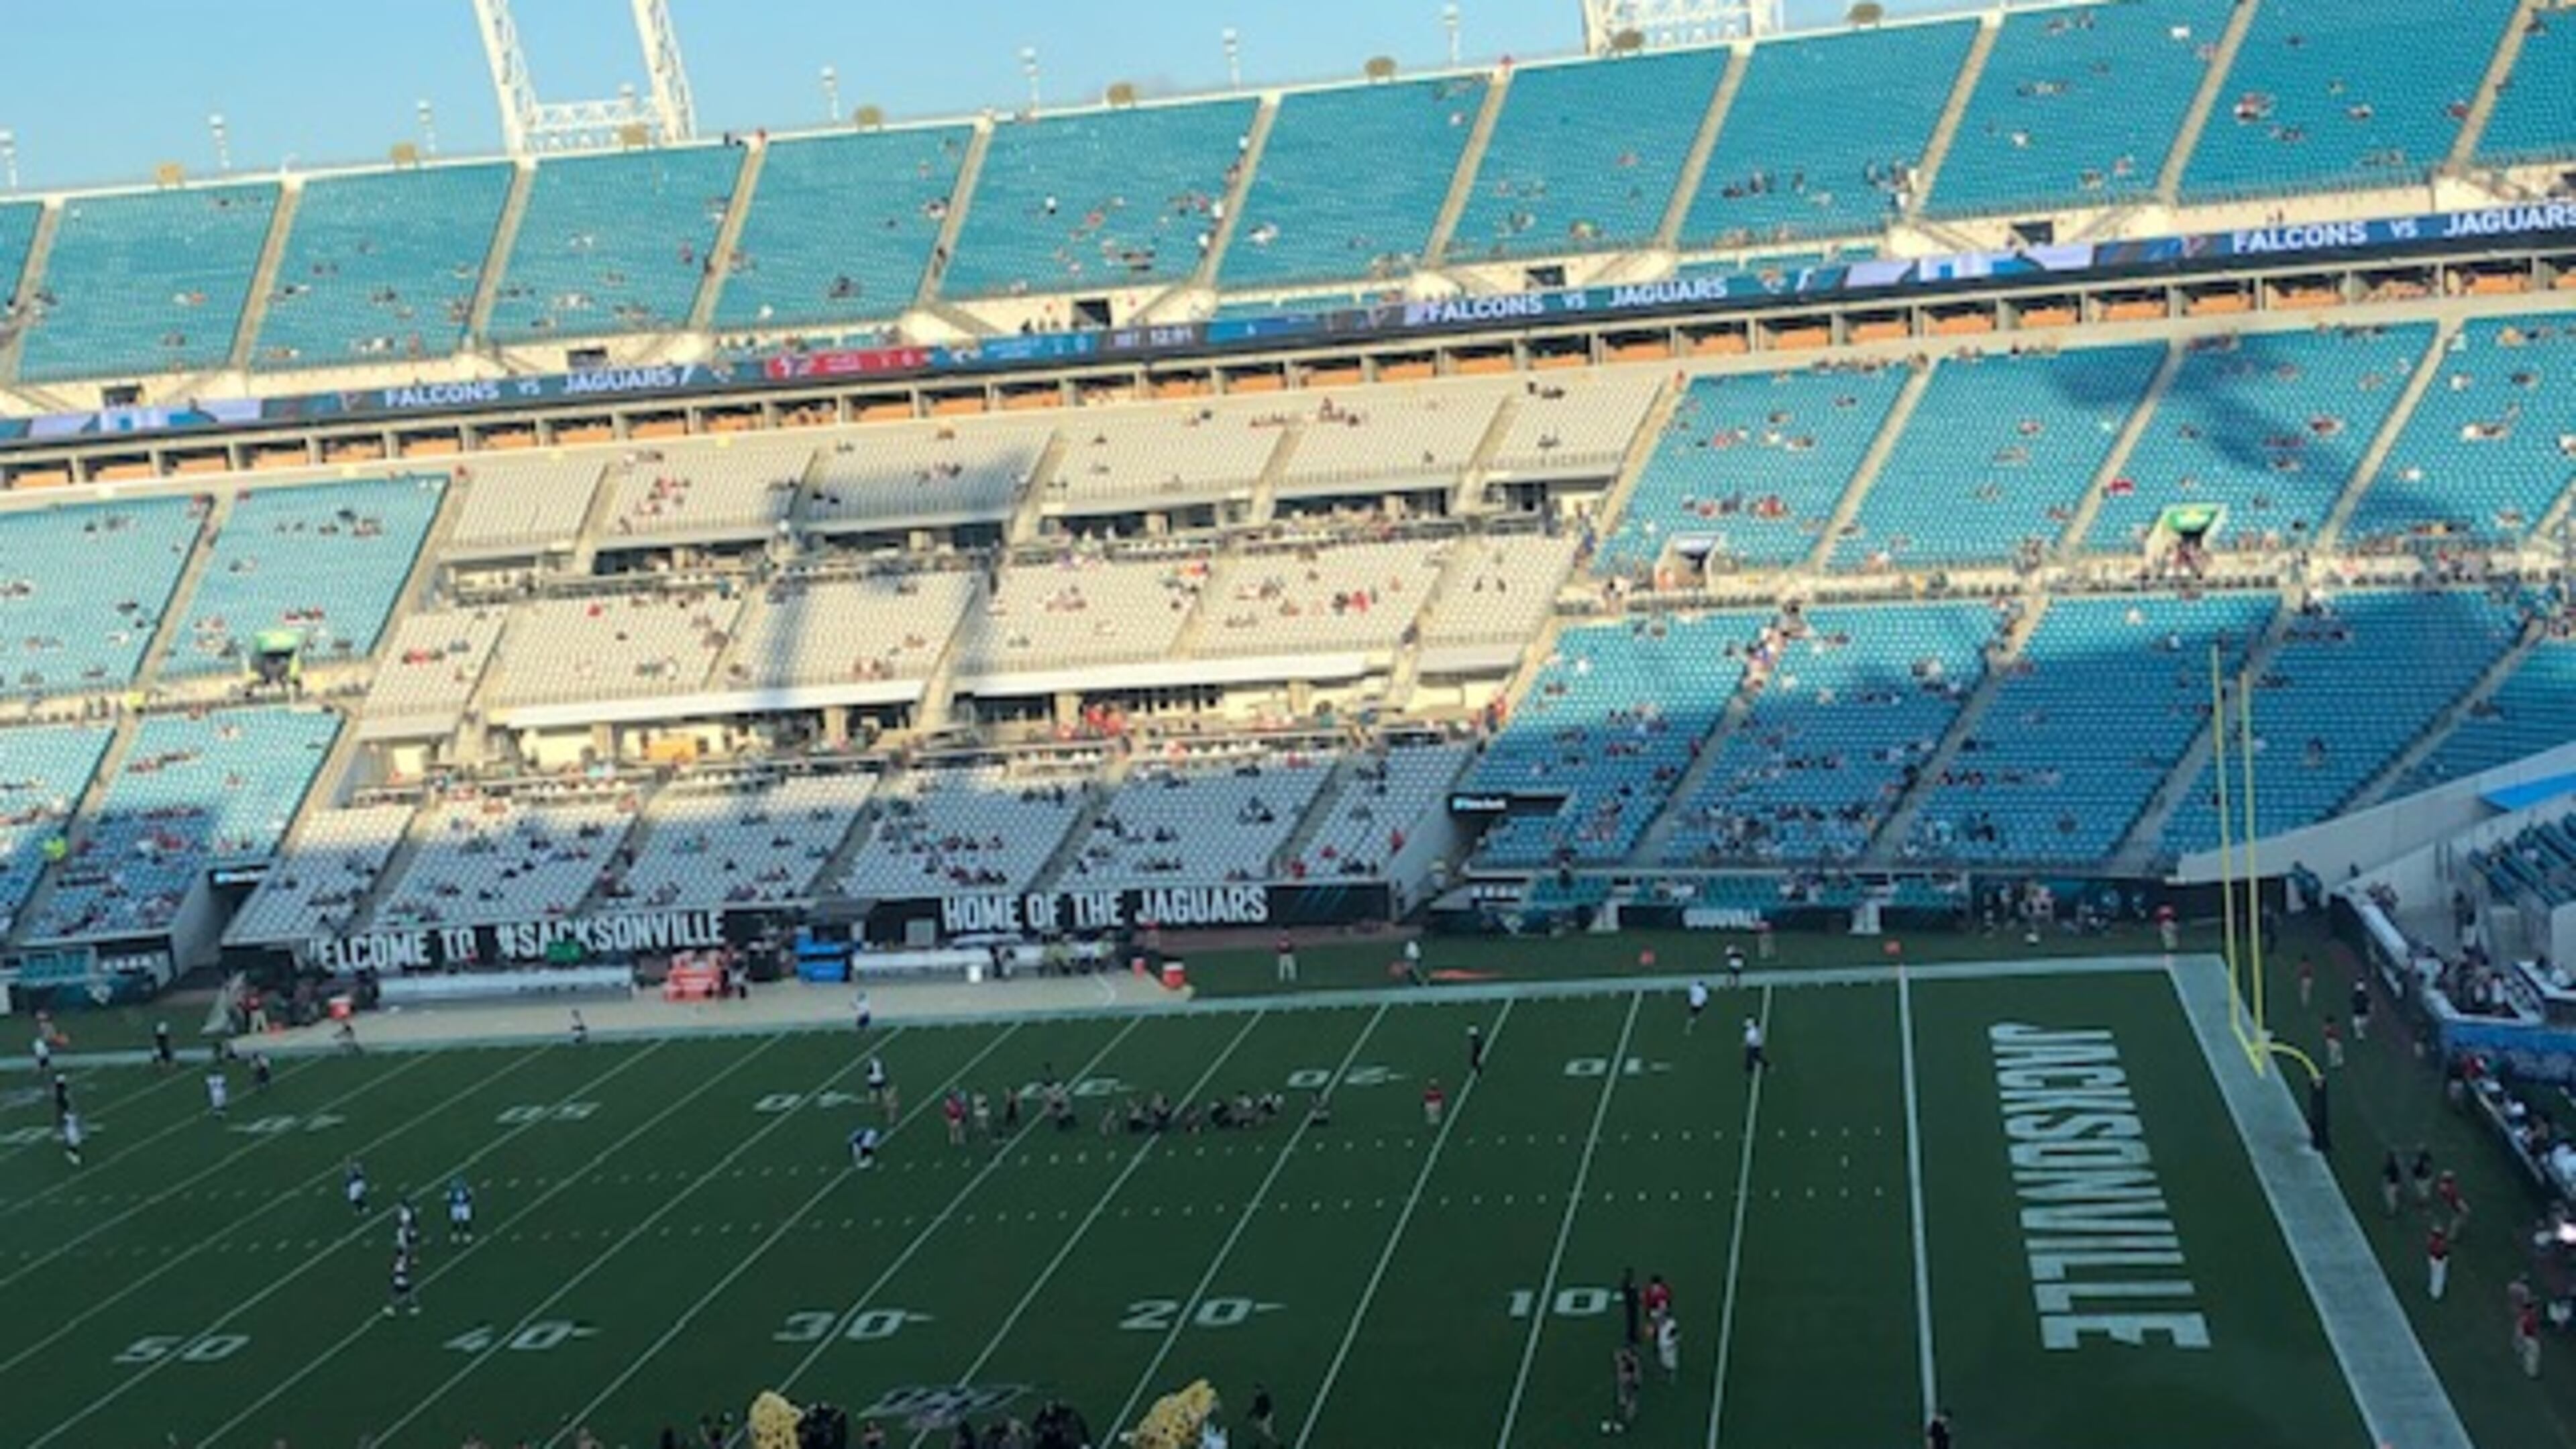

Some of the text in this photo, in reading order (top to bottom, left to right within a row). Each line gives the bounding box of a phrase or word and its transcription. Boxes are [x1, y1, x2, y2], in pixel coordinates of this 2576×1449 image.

[2233, 221, 2367, 254] FALCONS
[2443, 203, 2576, 237] JAGUARS
[1426, 294, 1543, 321] FALCONS
[1607, 277, 1728, 308] JAGUARS
[385, 381, 499, 407] FALCONS
[561, 369, 672, 393] JAGUARS
[943, 887, 1269, 932] HOME OF THE JAGUARS
[440, 927, 476, 960] TO
[1988, 1022, 2212, 1350] JACKSONVILLE
[1118, 1298, 1253, 1330] 20
[1509, 1287, 1609, 1316] 10
[443, 1321, 575, 1351] 40
[772, 1309, 907, 1341] 30
[113, 1334, 251, 1363] 50
